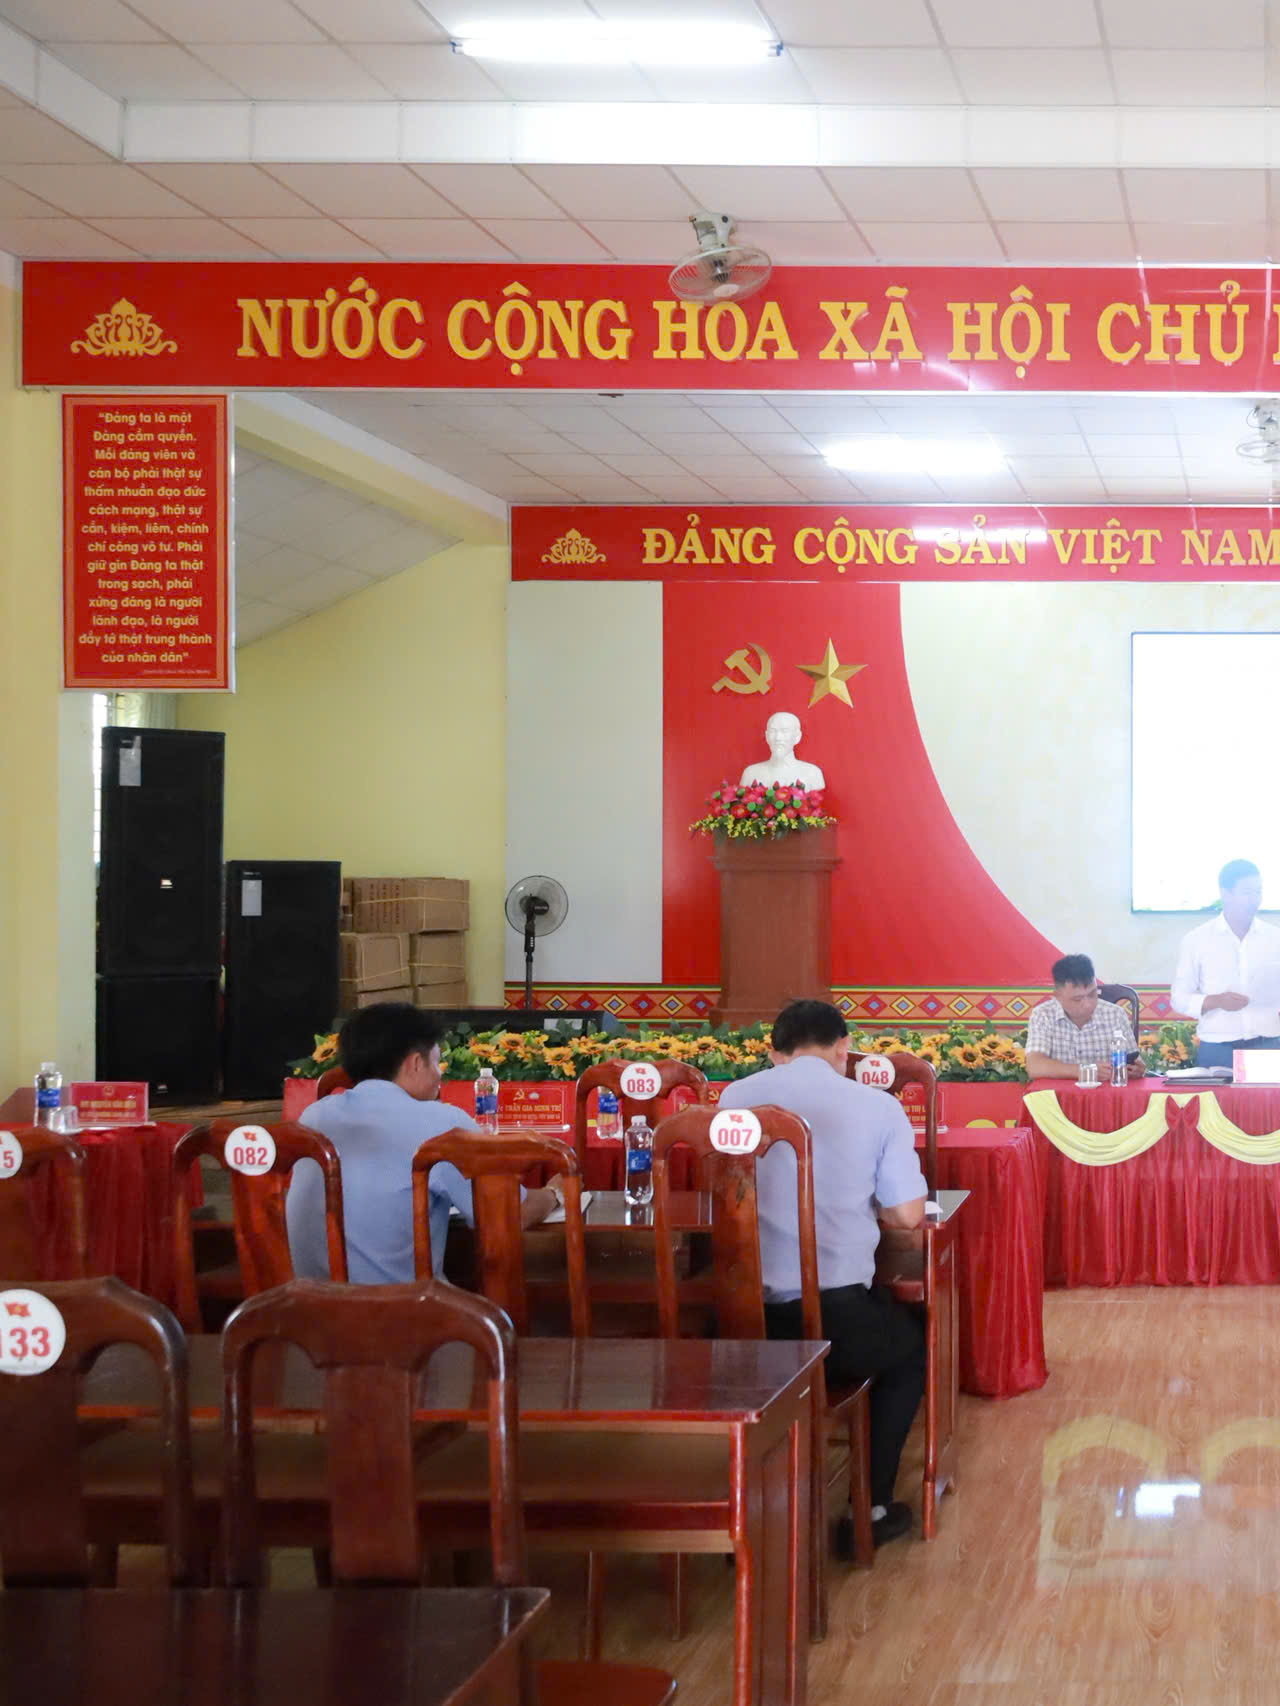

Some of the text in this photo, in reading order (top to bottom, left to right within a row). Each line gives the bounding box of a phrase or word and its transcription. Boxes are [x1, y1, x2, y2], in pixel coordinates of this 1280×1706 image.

[236, 277, 424, 359] NƯỚC
[447, 282, 631, 375] CỘNG
[818, 286, 922, 361] XÃ
[947, 285, 1071, 378] HỘI
[1097, 280, 1249, 364] CHỦ
[642, 514, 776, 565] ĐẢNG
[793, 516, 918, 573] CỘNG
[934, 514, 1030, 565] SẢN
[1048, 519, 1162, 573] VIỆT
[626, 1079, 655, 1093] 083
[862, 1071, 889, 1085] 048
[718, 1128, 753, 1146] 007
[233, 1147, 268, 1166] 082
[0, 1327, 51, 1358] 33
